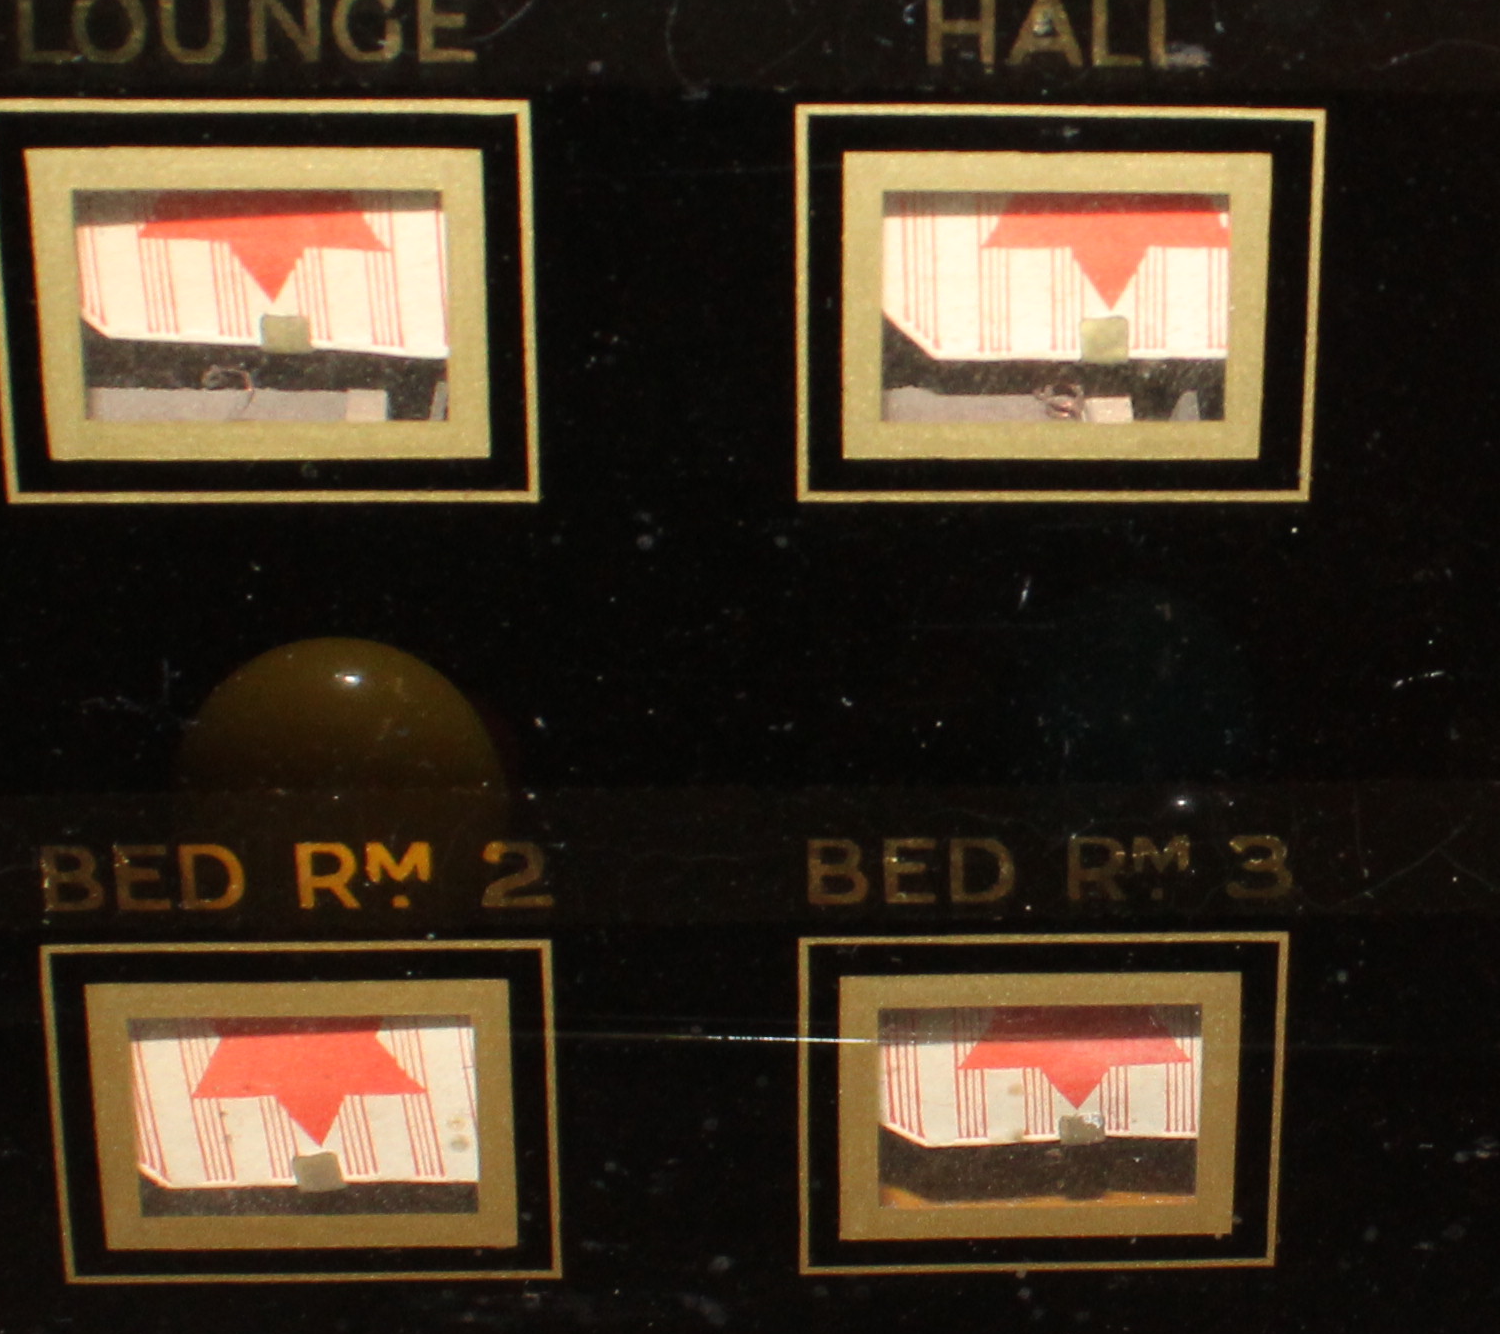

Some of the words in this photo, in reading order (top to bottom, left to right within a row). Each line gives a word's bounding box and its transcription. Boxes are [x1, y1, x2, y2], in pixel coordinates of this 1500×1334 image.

[40, 842, 247, 913] BED
[481, 840, 556, 909] 2
[806, 837, 1016, 905] BED
[1227, 834, 1294, 900] 3
